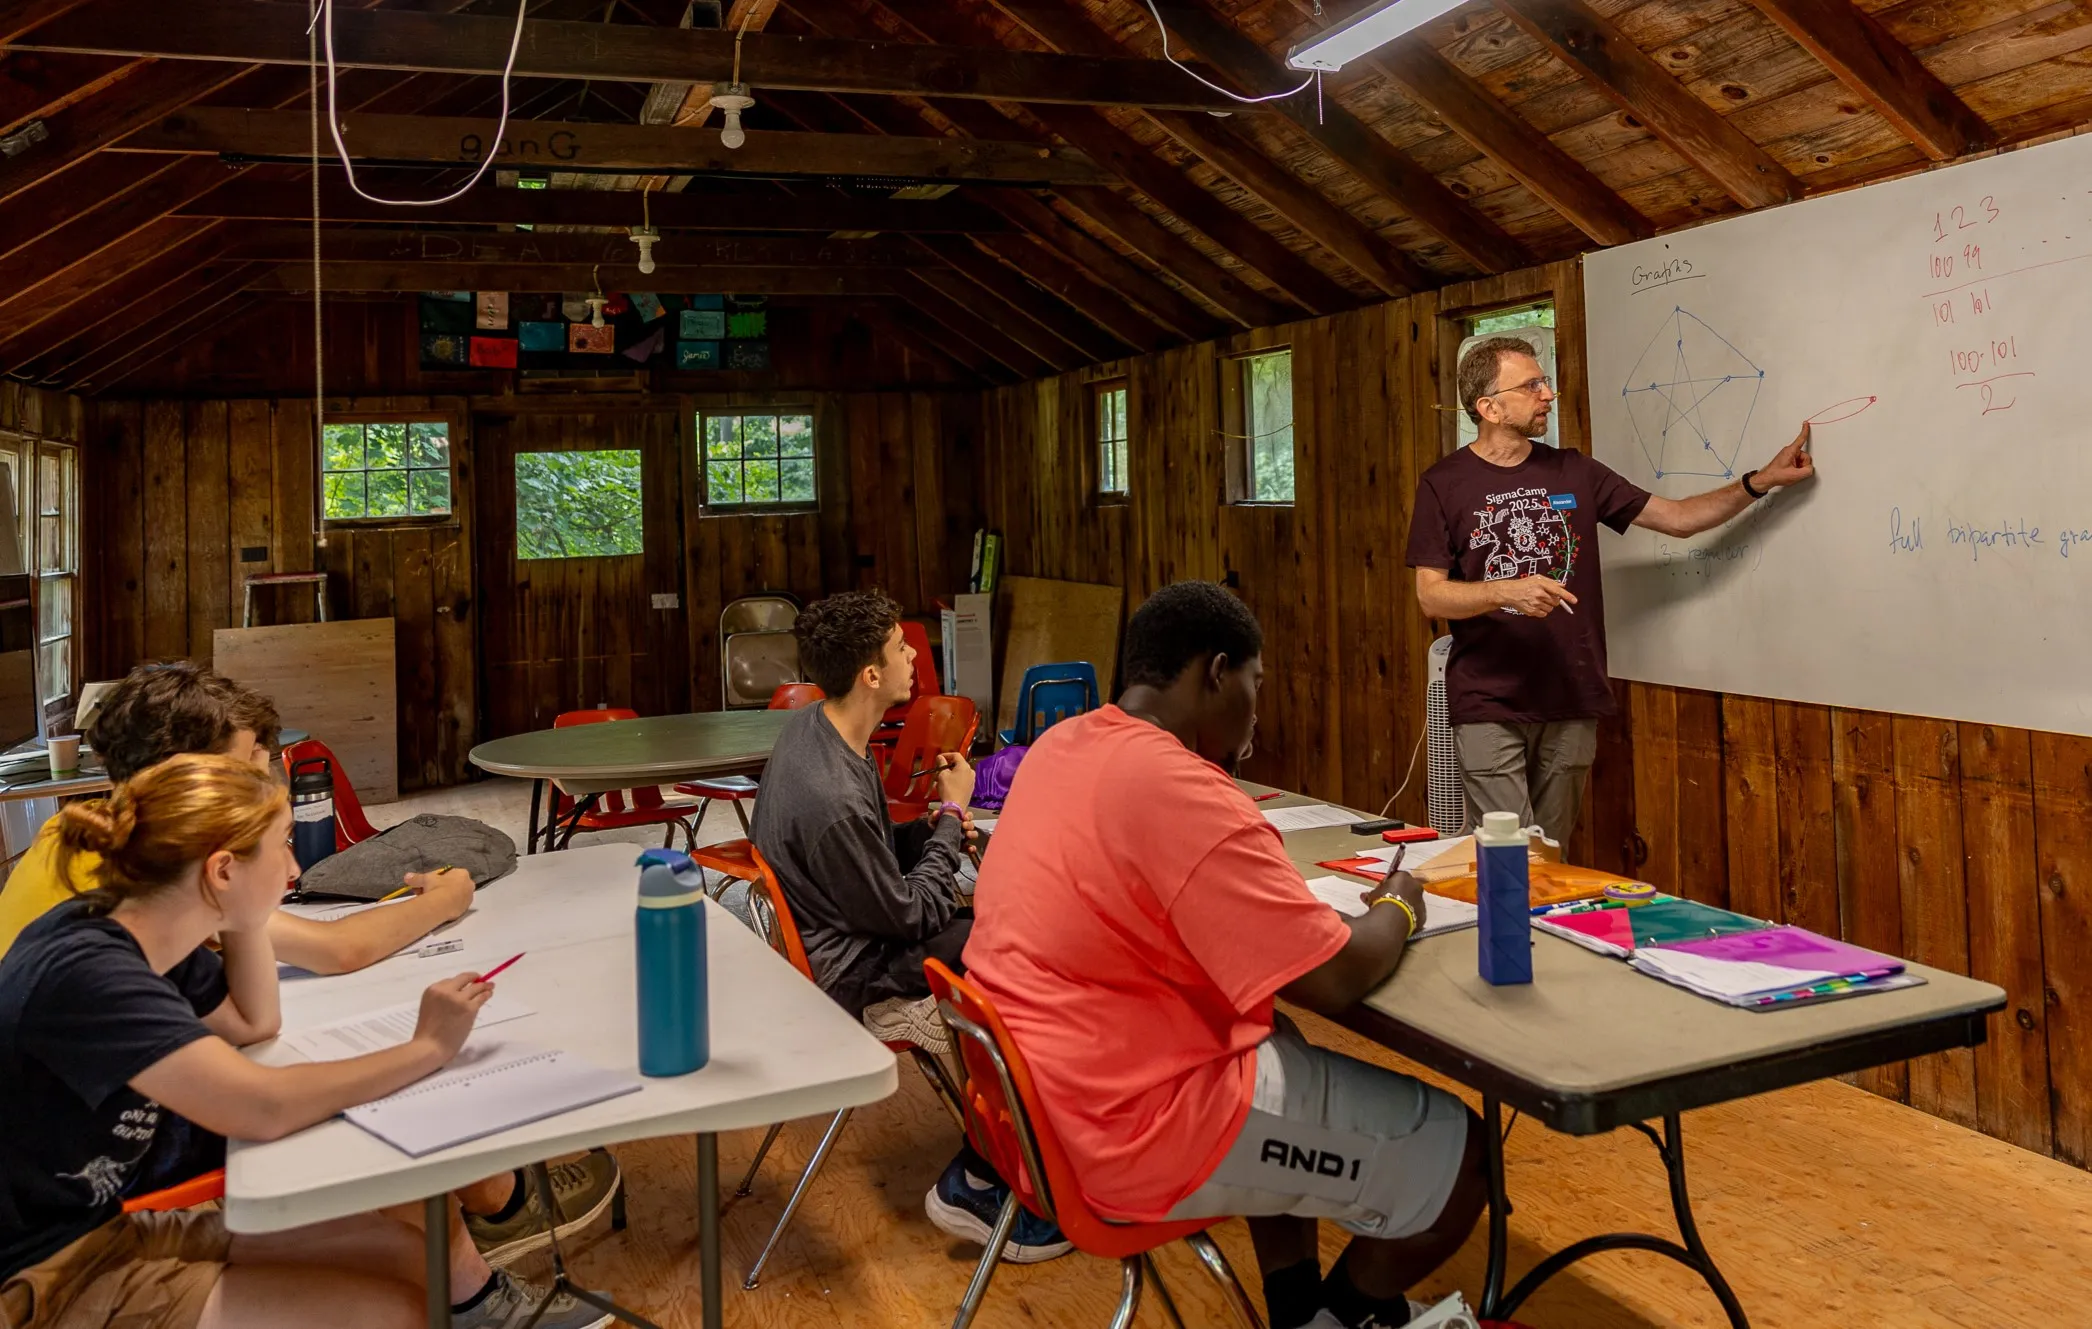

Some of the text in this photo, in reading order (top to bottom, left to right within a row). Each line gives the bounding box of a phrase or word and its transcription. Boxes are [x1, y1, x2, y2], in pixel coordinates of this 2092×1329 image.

[1933, 195, 2000, 243] 1 2 3
[1631, 258, 1693, 286] Graphs
[1929, 244, 1982, 279] 100 99
[1932, 299, 1955, 328] 101
[1980, 384, 2016, 416] 2
[1485, 487, 1547, 505] SigmaCamp
[1508, 498, 1539, 512] 2025
[1889, 506, 1923, 555] full
[1947, 517, 2045, 562] bipartite
